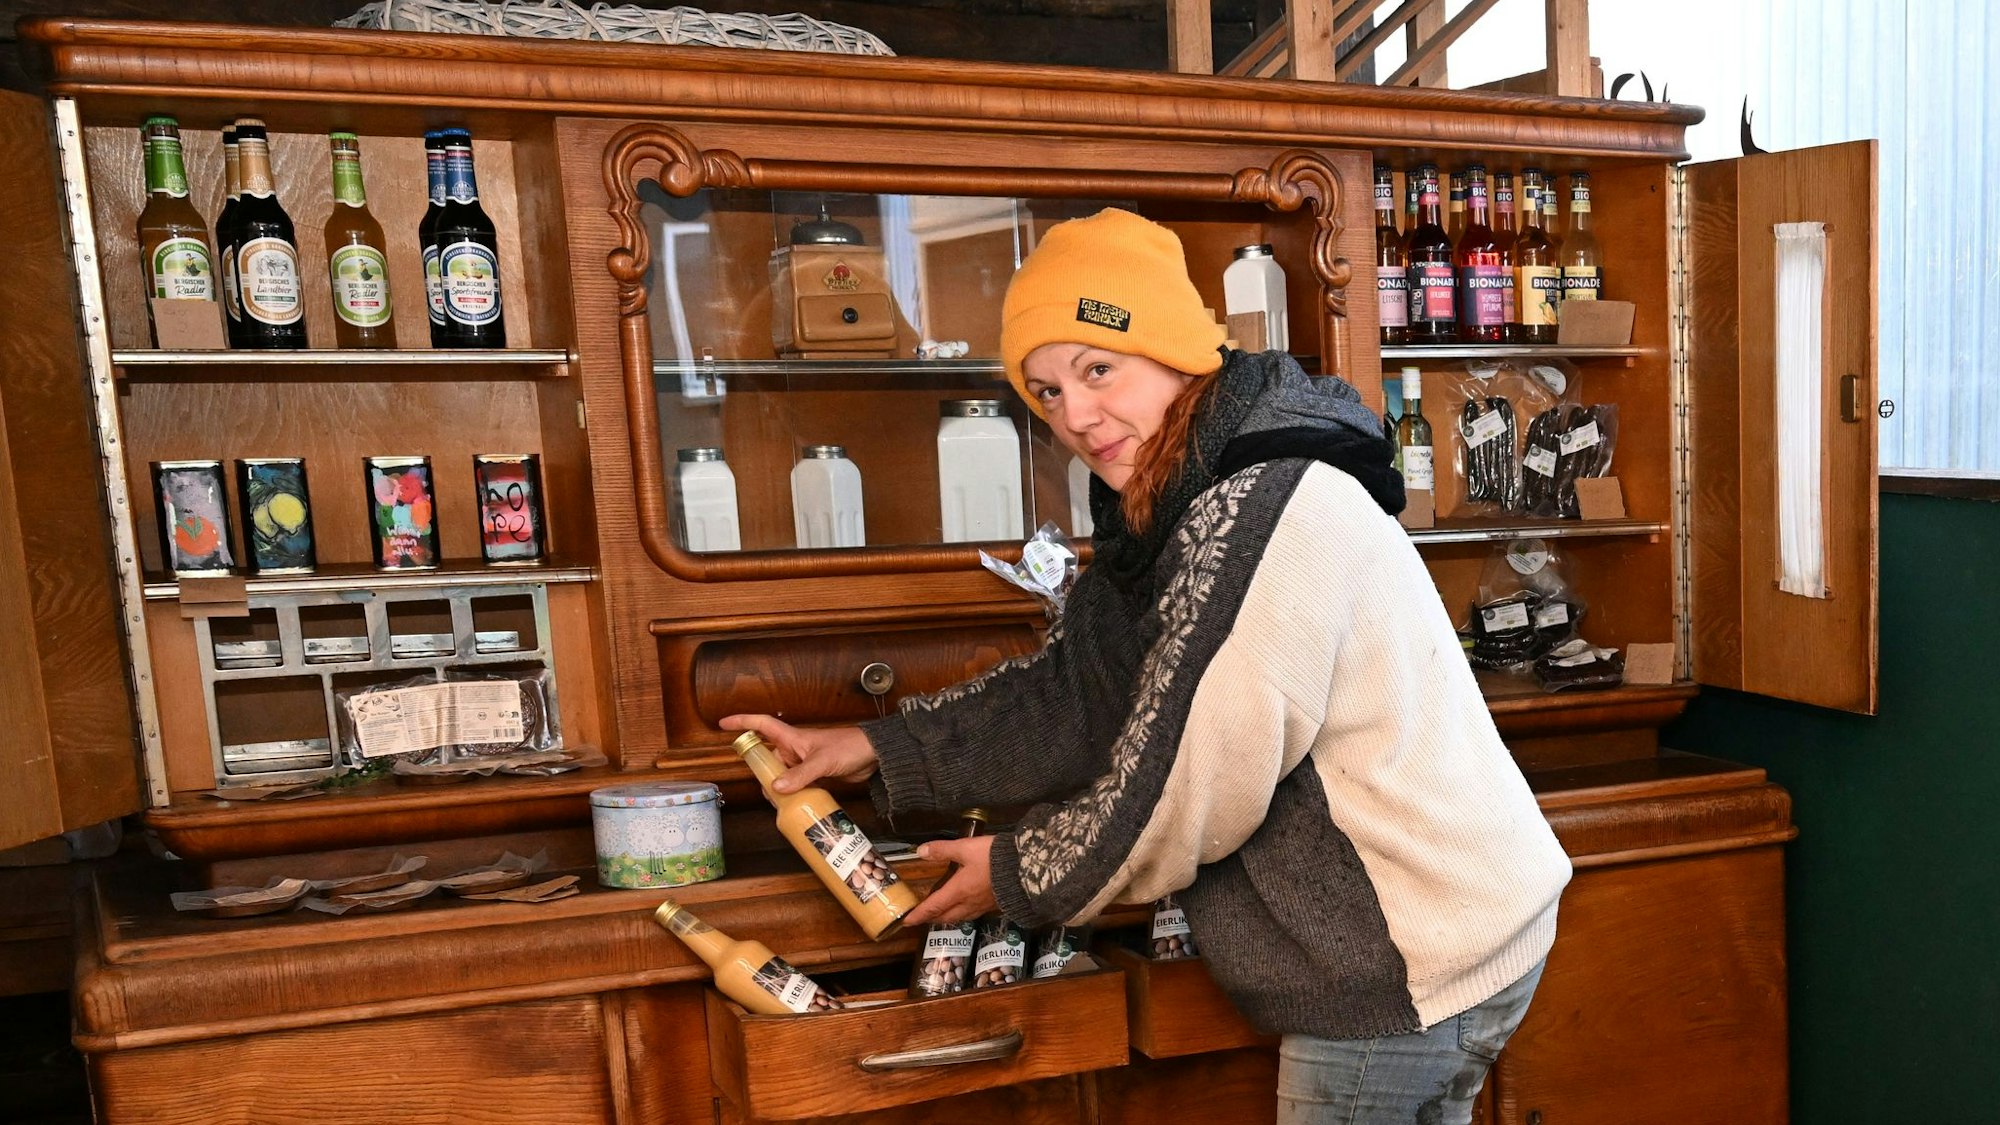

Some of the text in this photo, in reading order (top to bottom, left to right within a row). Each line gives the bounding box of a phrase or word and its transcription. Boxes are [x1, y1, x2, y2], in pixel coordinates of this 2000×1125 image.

[1497, 192, 1512, 201] BIO
[1574, 191, 1590, 200] BIO
[174, 285, 206, 296] Radler
[832, 831, 866, 868] EIERLIKÖR
[929, 937, 972, 947] EIERLIKÖR
[978, 946, 1021, 963] EIERLIKÖR
